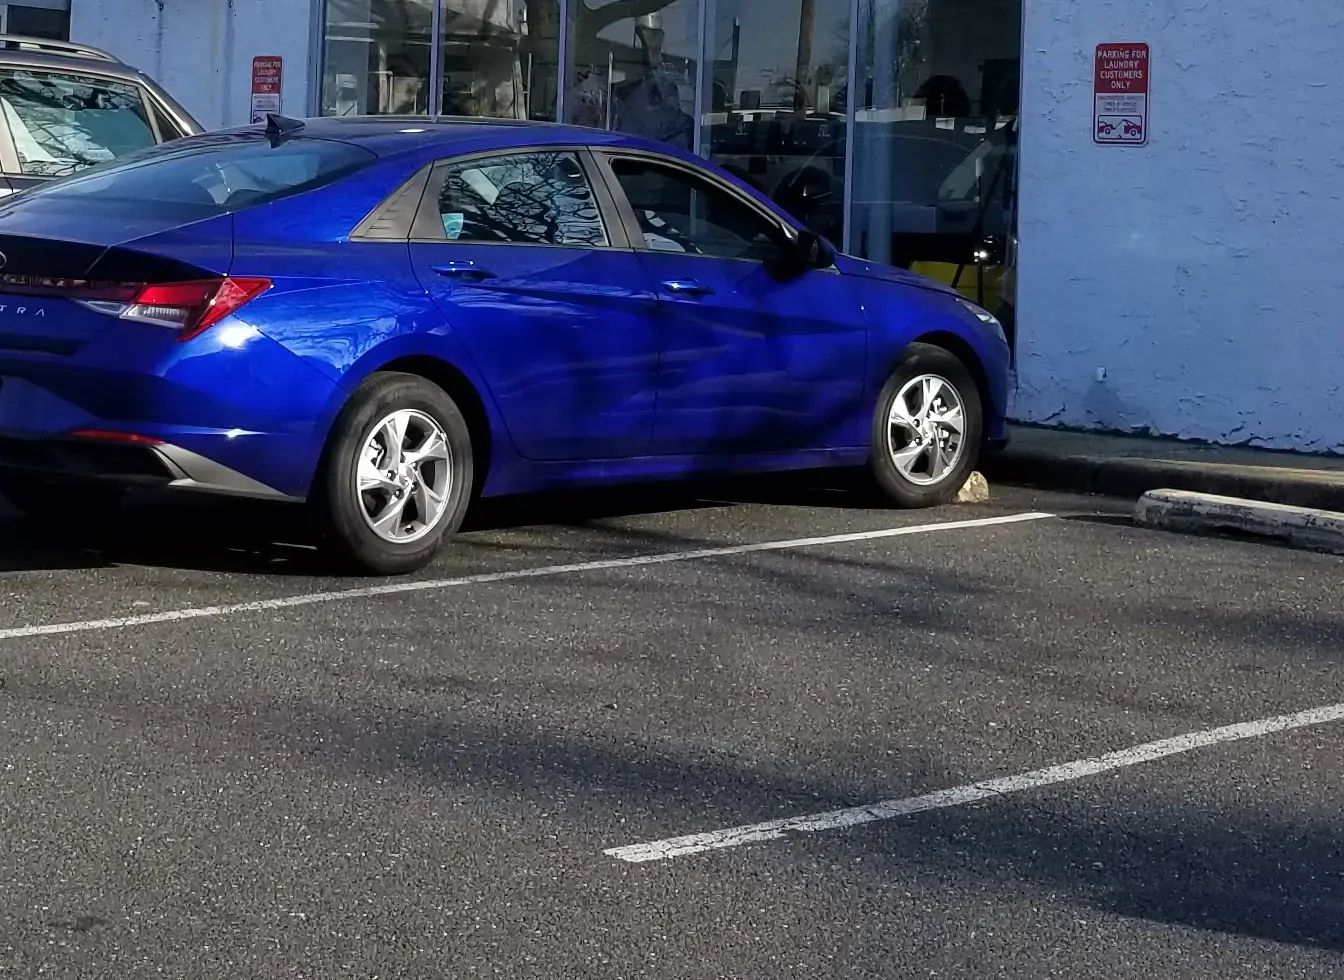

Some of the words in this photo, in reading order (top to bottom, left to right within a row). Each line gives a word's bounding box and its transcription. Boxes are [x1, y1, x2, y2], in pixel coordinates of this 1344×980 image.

[1097, 50, 1130, 59] PARKING
[1132, 50, 1147, 59] FOR
[1104, 60, 1140, 69] LAUNDRY
[1099, 70, 1143, 79] CUSTOMERS
[1110, 80, 1131, 89] ONLY
